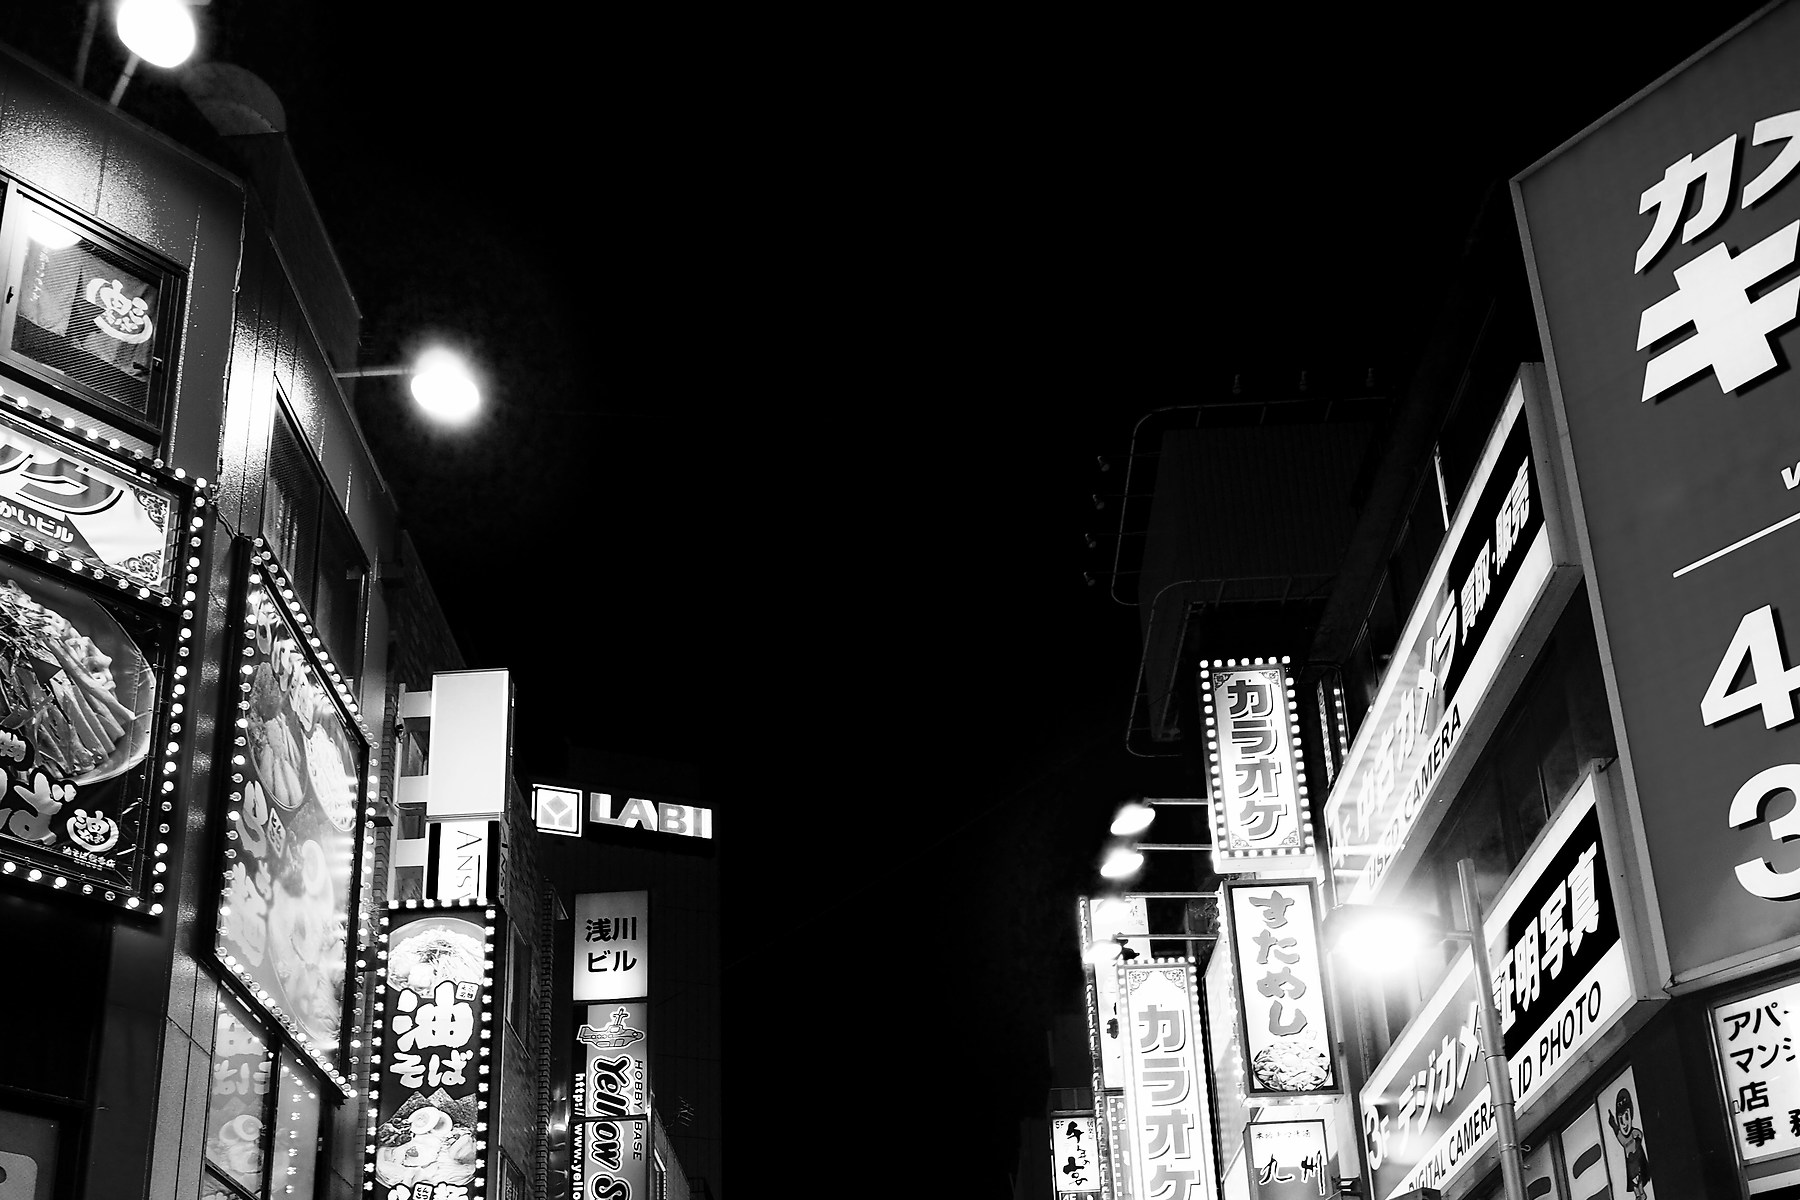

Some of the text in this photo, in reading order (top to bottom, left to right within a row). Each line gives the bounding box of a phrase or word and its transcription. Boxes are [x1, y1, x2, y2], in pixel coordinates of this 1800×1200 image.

[1227, 680, 1288, 841] カラオケ
[1404, 704, 1461, 822] CAMERA
[590, 792, 713, 840] LABI
[585, 917, 637, 943] 浅川
[588, 950, 637, 973] ビル
[392, 980, 474, 1052] 油
[1518, 981, 1602, 1098] ID PHOTO
[1723, 1002, 1789, 1041] アパ
[390, 1050, 474, 1089] そば
[1739, 1081, 1770, 1112] 店
[590, 1055, 630, 1173] Yellow
[632, 1060, 644, 1161] HOBBY BASE
[1449, 1105, 1496, 1165] CAMERA
[1259, 1151, 1325, 1195] 九州
